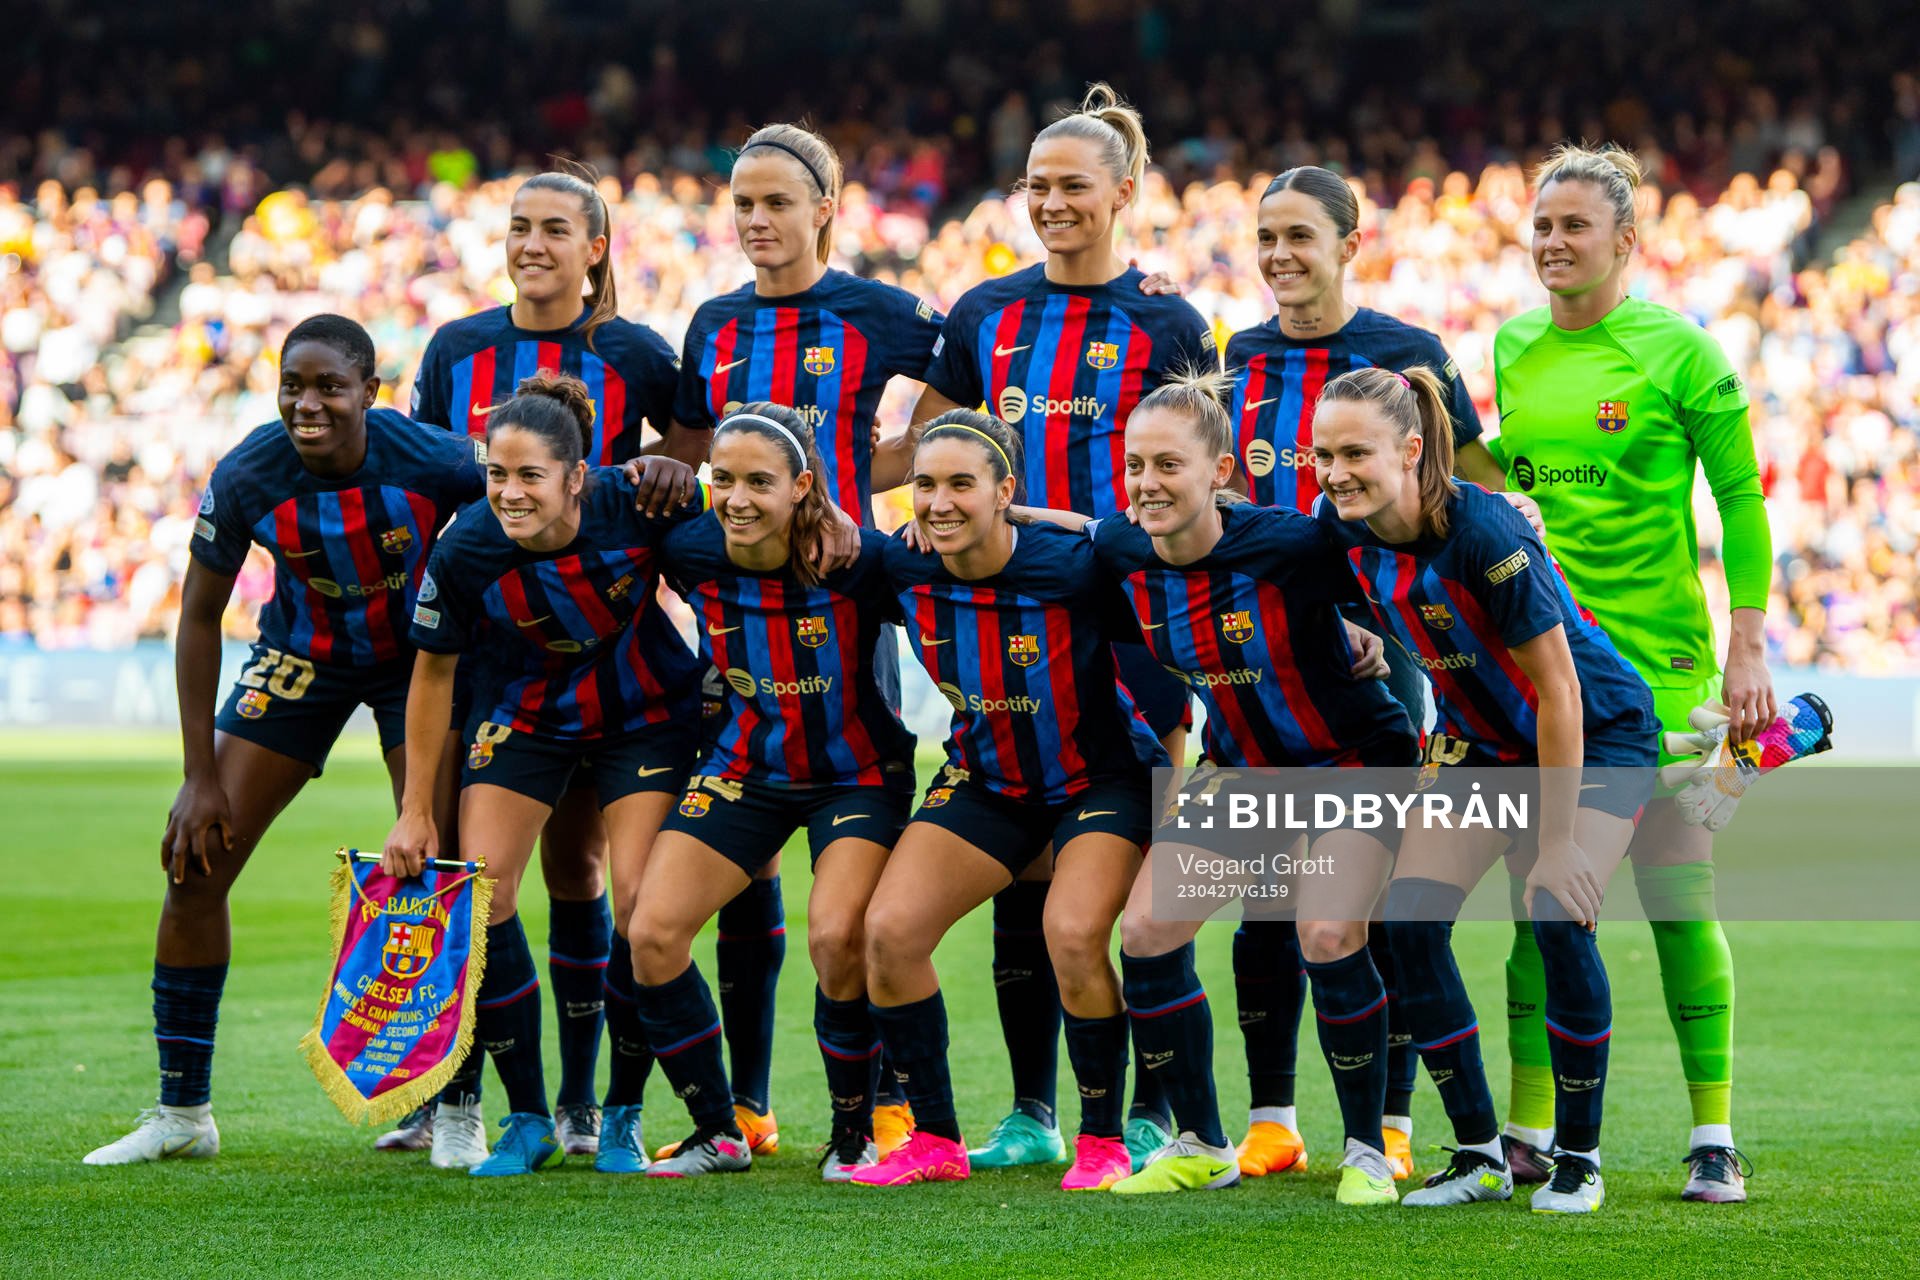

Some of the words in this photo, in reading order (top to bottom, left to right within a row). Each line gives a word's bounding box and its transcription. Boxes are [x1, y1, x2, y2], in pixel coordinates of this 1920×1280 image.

[795, 404, 829, 427] tify
[1031, 395, 1107, 420] Spotify
[1538, 464, 1608, 487] Spotify
[1486, 549, 1530, 584] BIMBO
[346, 571, 409, 597] Spotif
[1411, 651, 1478, 673] Spotify
[234, 648, 316, 700] 20
[1195, 667, 1263, 689] Spotify
[759, 675, 833, 697] Spotify
[968, 694, 1041, 715] Spotify
[361, 900, 380, 923] FC
[357, 974, 413, 1005] CHELSEA
[419, 984, 437, 1002] FC
[340, 1007, 382, 1035] SEMIFINAL
[385, 1025, 419, 1038] SECOND
[422, 1019, 441, 1034] LEG
[367, 1004, 424, 1023] CHAMPIONS
[366, 1037, 388, 1049] CAMP
[364, 1050, 401, 1064] THURSDAY
[365, 1063, 387, 1076] APRIL
